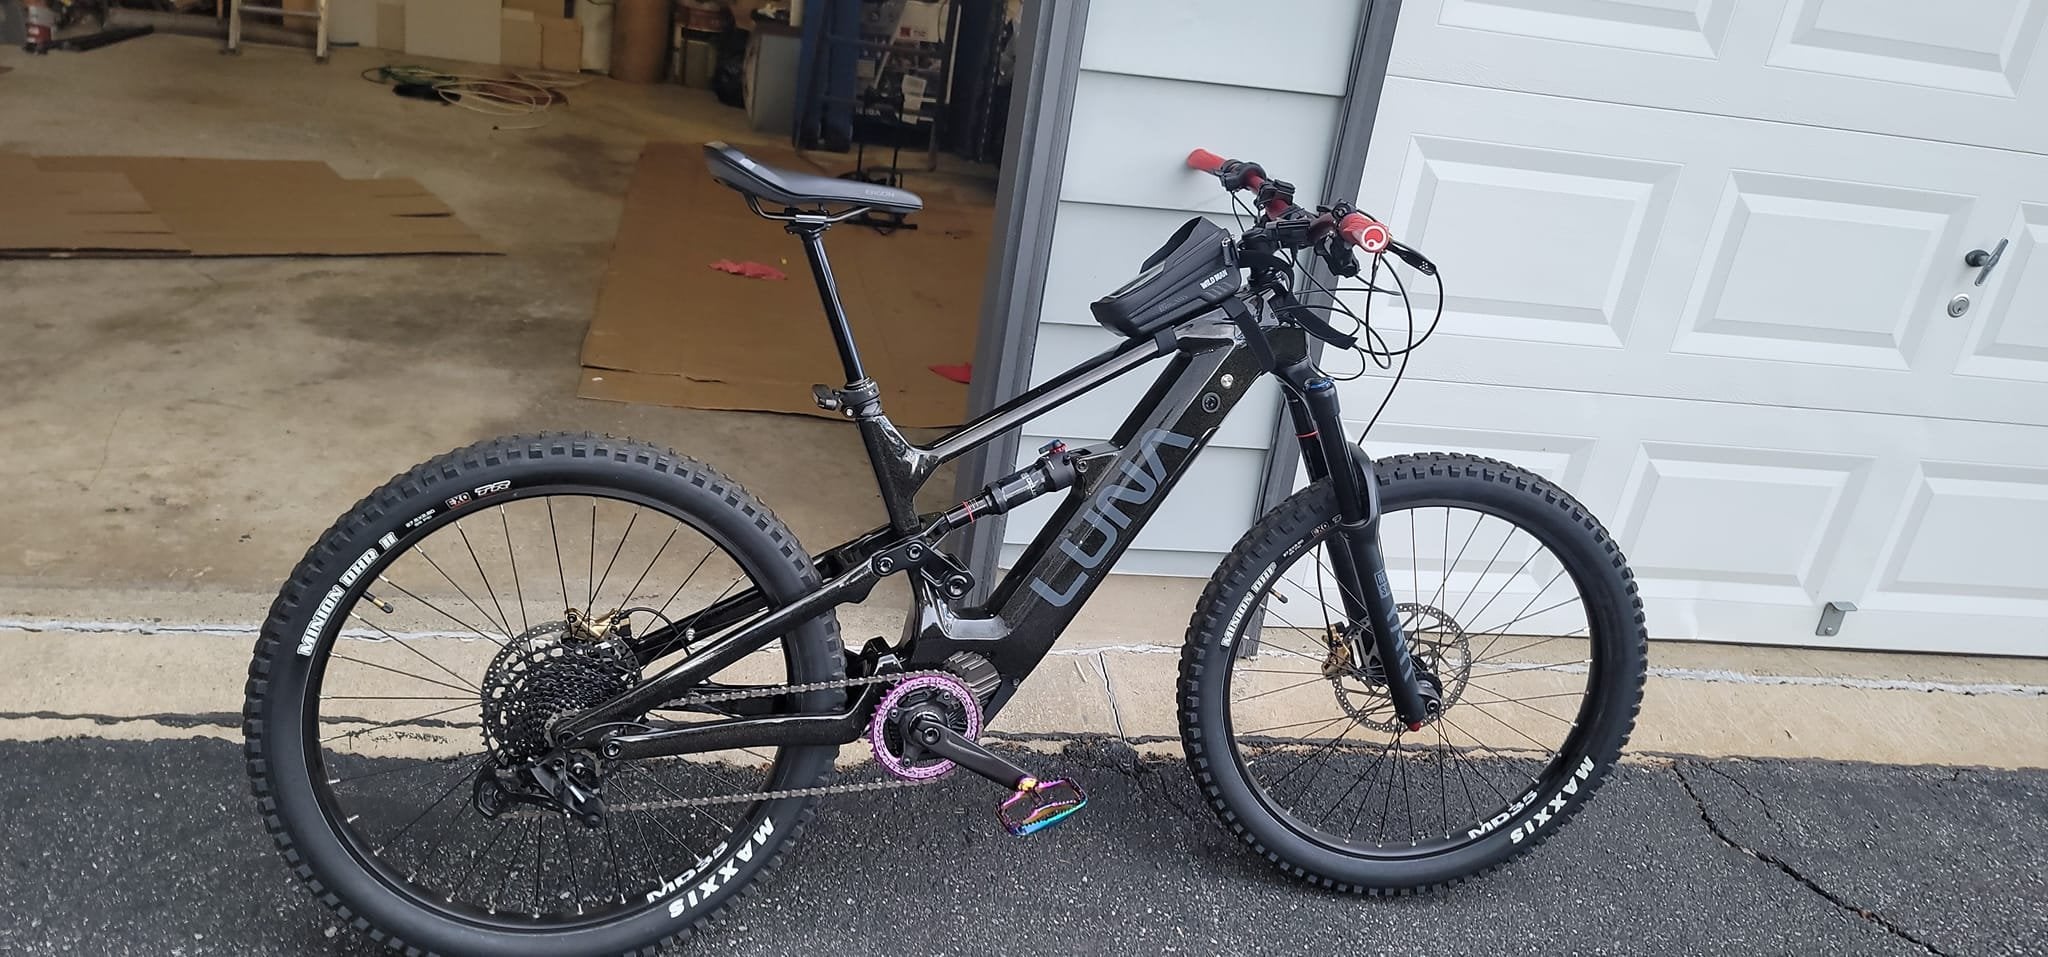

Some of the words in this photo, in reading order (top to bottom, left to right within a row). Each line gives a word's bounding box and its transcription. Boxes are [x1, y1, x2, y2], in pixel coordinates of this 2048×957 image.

[1200, 276, 1216, 289] WILD
[1214, 269, 1228, 282] MAN
[1029, 428, 1195, 607] LUNA
[297, 584, 346, 656] MINION
[338, 548, 379, 588] DHR
[1220, 591, 1255, 647] MINION
[1467, 789, 1538, 840] MD35
[1510, 755, 1595, 845] MAXXIS
[668, 816, 775, 919] MAXXIS
